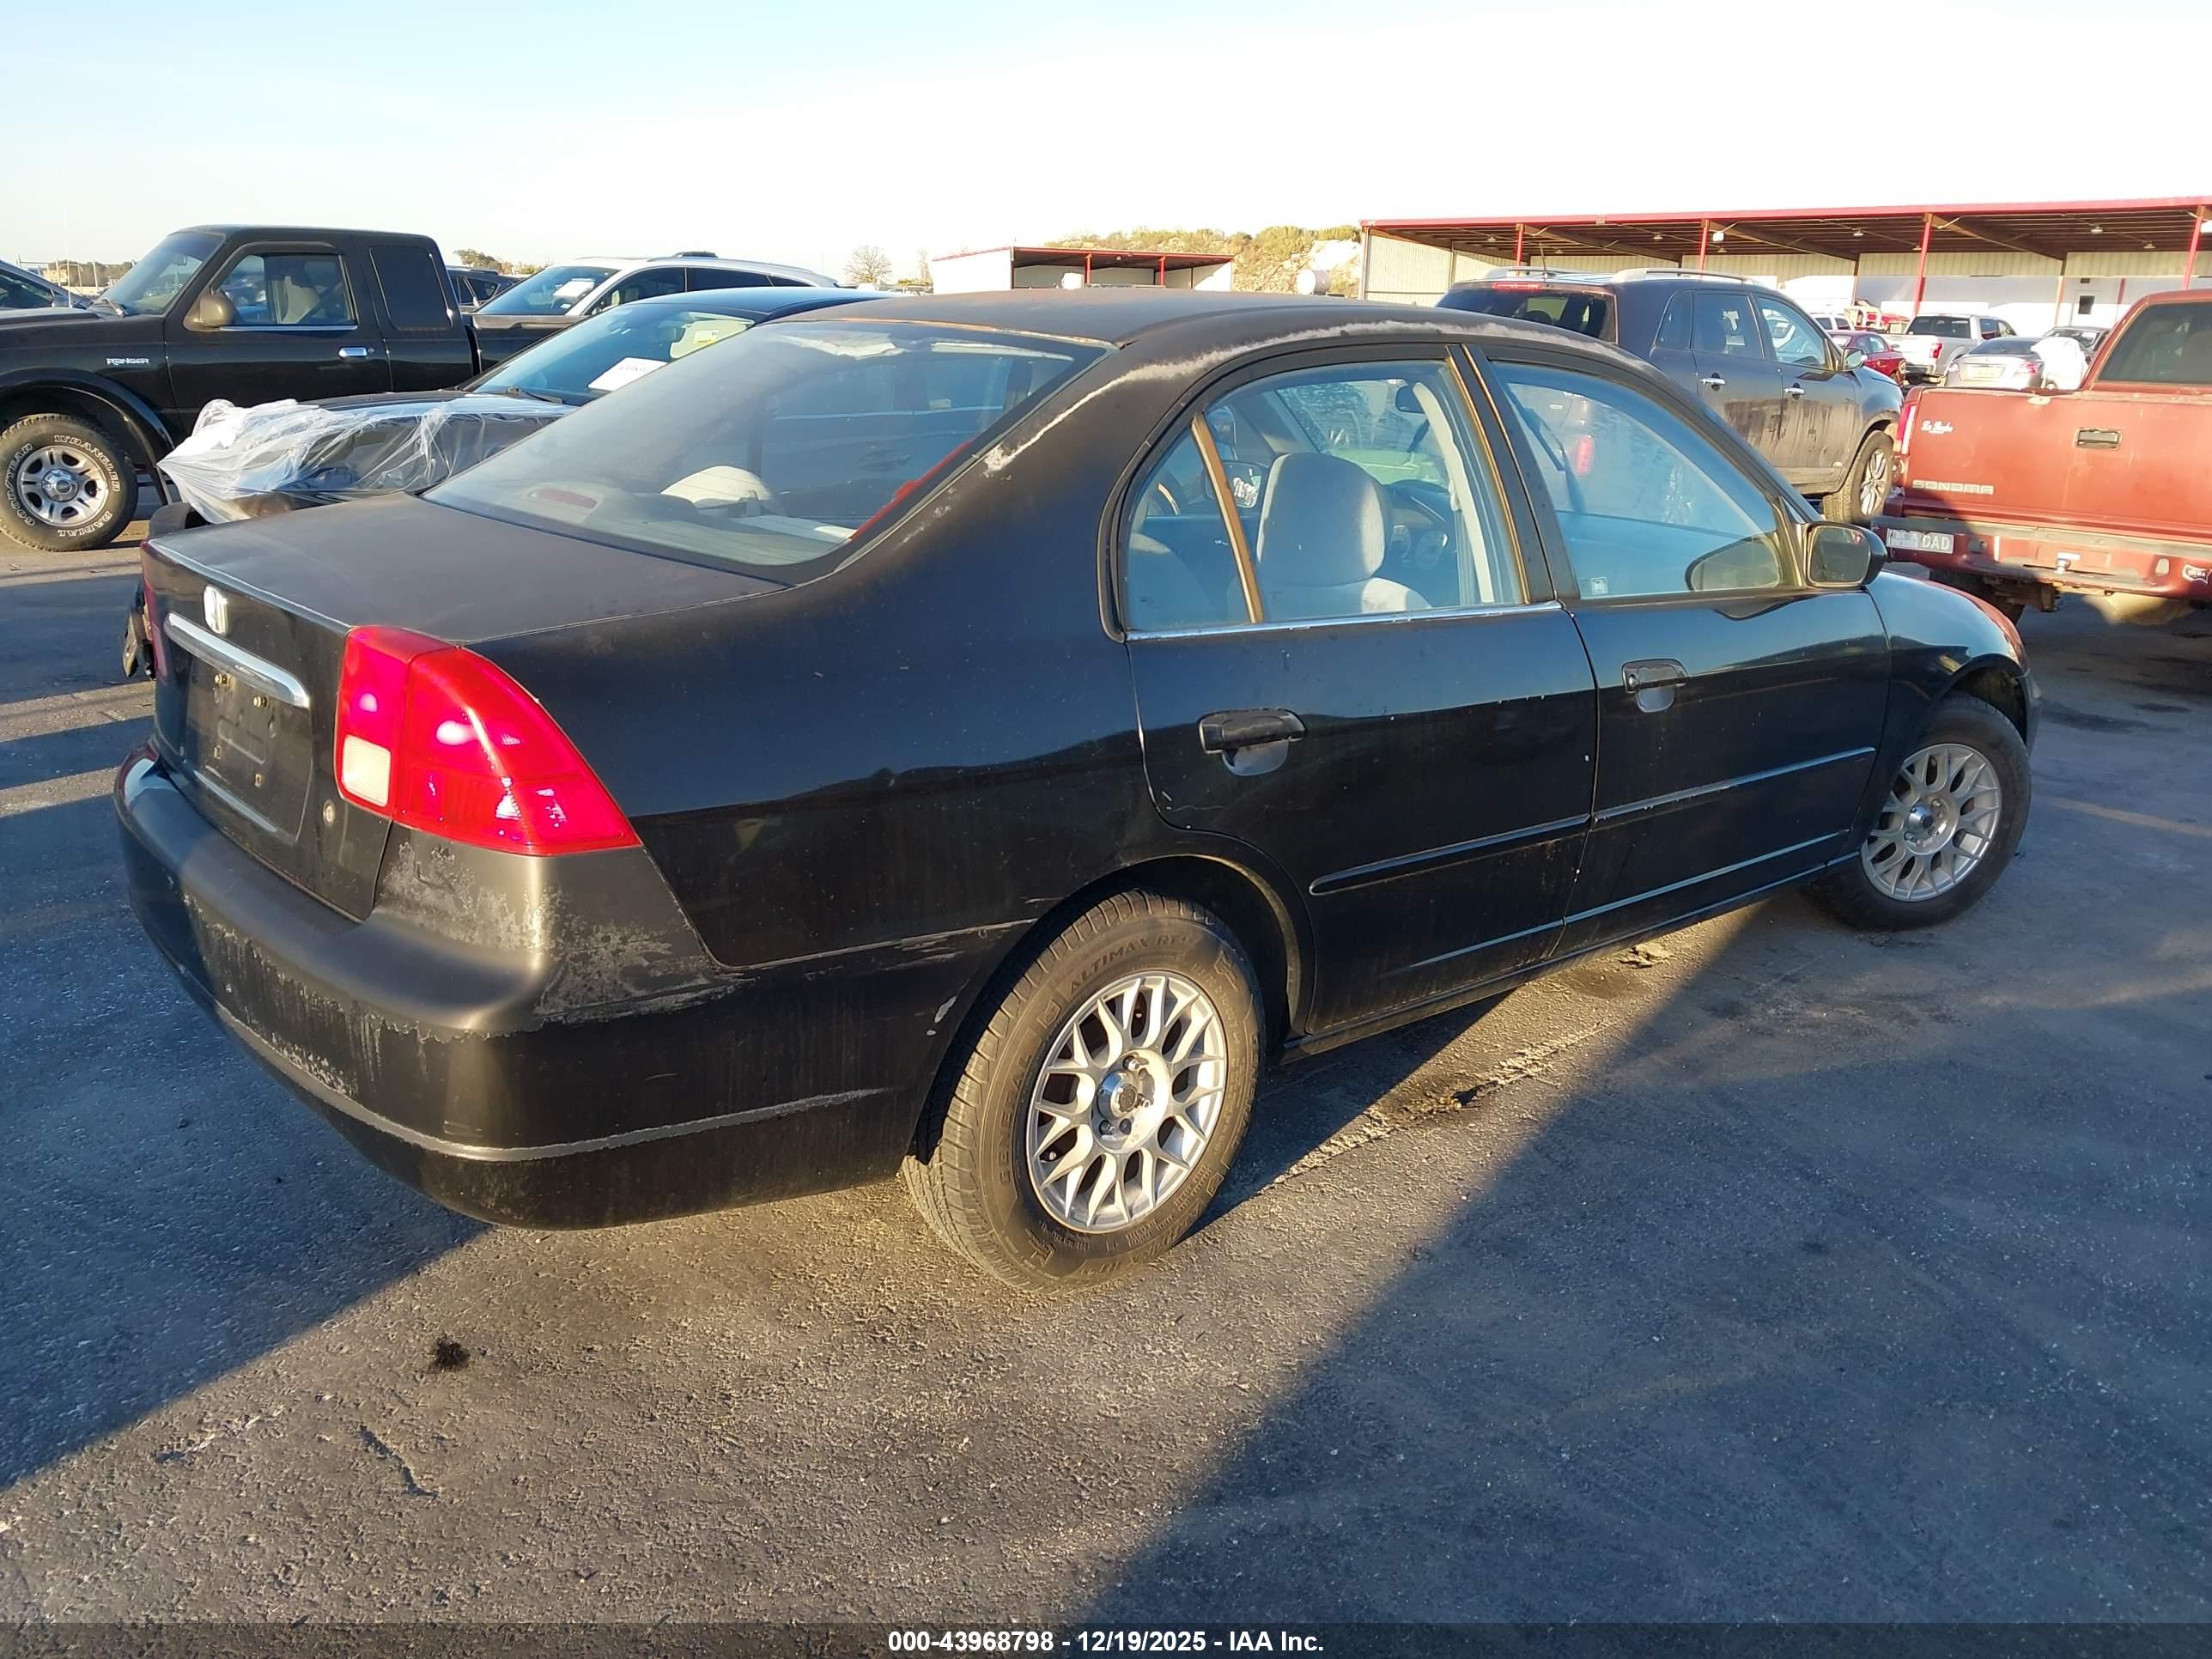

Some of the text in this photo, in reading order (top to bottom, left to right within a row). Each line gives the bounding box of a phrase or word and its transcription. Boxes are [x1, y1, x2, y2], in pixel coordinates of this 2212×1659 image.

[106, 357, 150, 366] RANGER
[53, 434, 121, 492] WRANGLER
[1912, 479, 1995, 495] SONOMA
[57, 510, 113, 537] RADIAL
